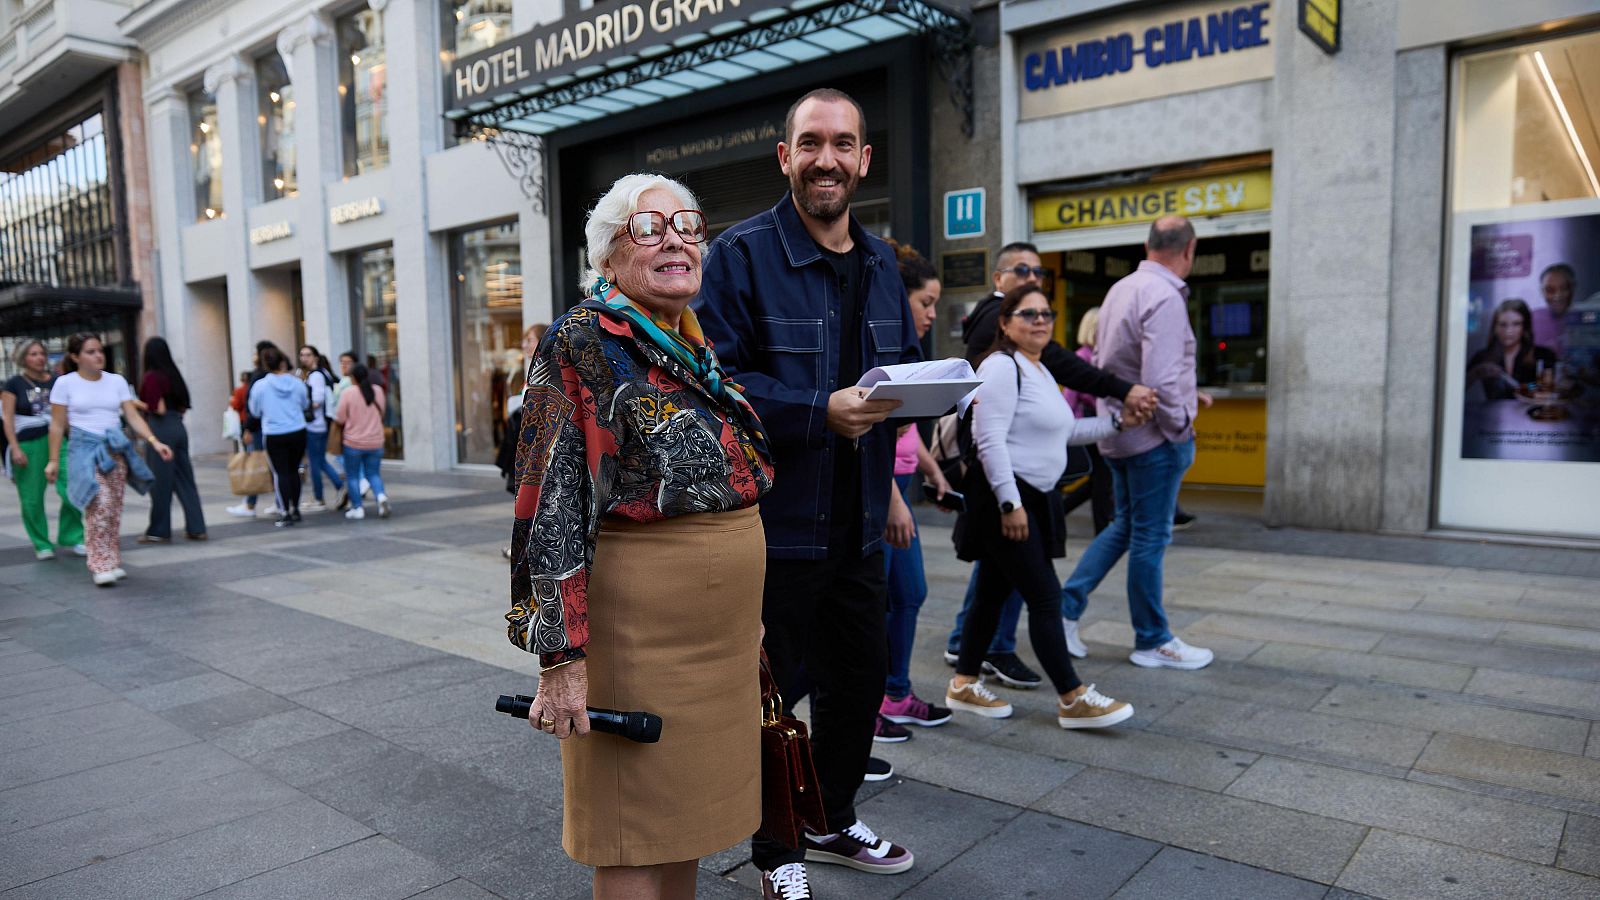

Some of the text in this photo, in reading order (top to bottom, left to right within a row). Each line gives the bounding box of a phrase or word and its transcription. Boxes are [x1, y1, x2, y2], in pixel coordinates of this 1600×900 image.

[455, 0, 741, 99] HOTEL MADRID GRA
[1024, 2, 1270, 92] CAMBIO-CHANGE
[330, 197, 381, 225] BERSHKA
[1057, 190, 1178, 225] CHANGE
